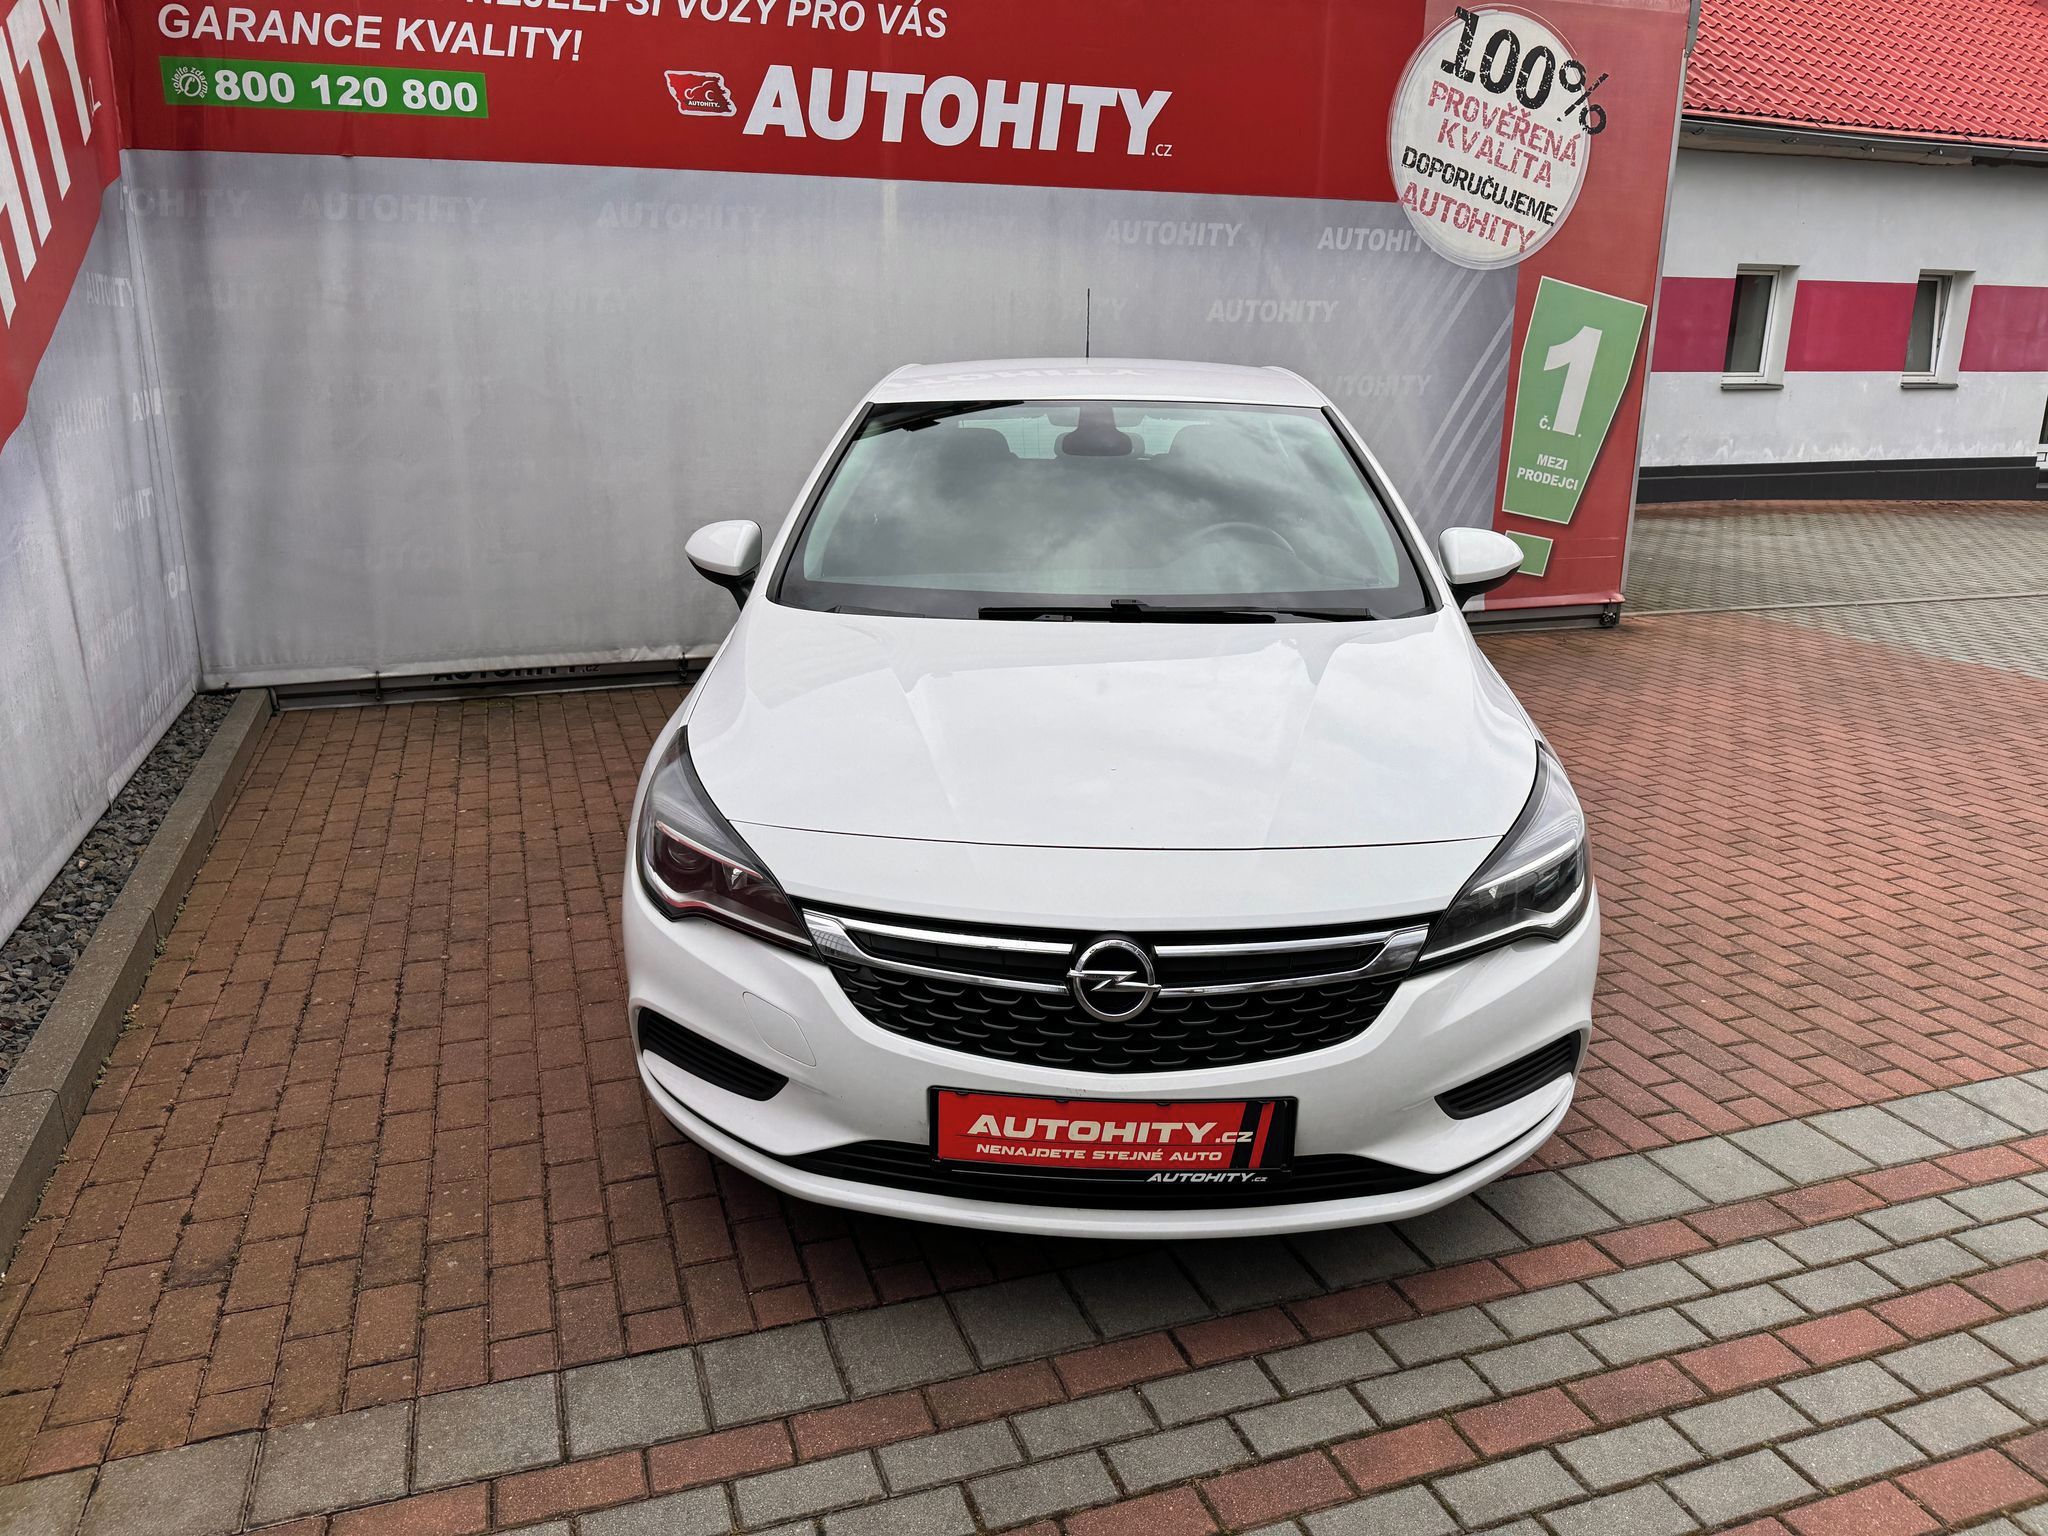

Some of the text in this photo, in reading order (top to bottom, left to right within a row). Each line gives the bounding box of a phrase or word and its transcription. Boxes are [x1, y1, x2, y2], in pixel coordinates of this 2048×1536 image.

[157, 3, 583, 62] GARANCE KVALITY!
[676, 0, 778, 25] VOZY
[787, 0, 866, 32] PRO
[877, 0, 948, 38] VÁS
[214, 69, 478, 112] 800 120 800
[1440, 5, 1610, 136] 100%
[1427, 80, 1582, 168] PROVĚŘENÁ
[1437, 117, 1552, 189] KVALITA
[1400, 145, 1559, 227] DOPORUČUJEME
[1101, 219, 1243, 248] AUTOHITY
[1399, 180, 1537, 254] AUTOHITY
[1316, 226, 1431, 252] AUTOHIT
[1206, 299, 1339, 323] AUTOHITY
[1516, 467, 1579, 491] PRODEJCI
[1536, 453, 1568, 472] MEZI
[976, 1143, 1223, 1162] NENAJDETE STEJNÉ AUTO
